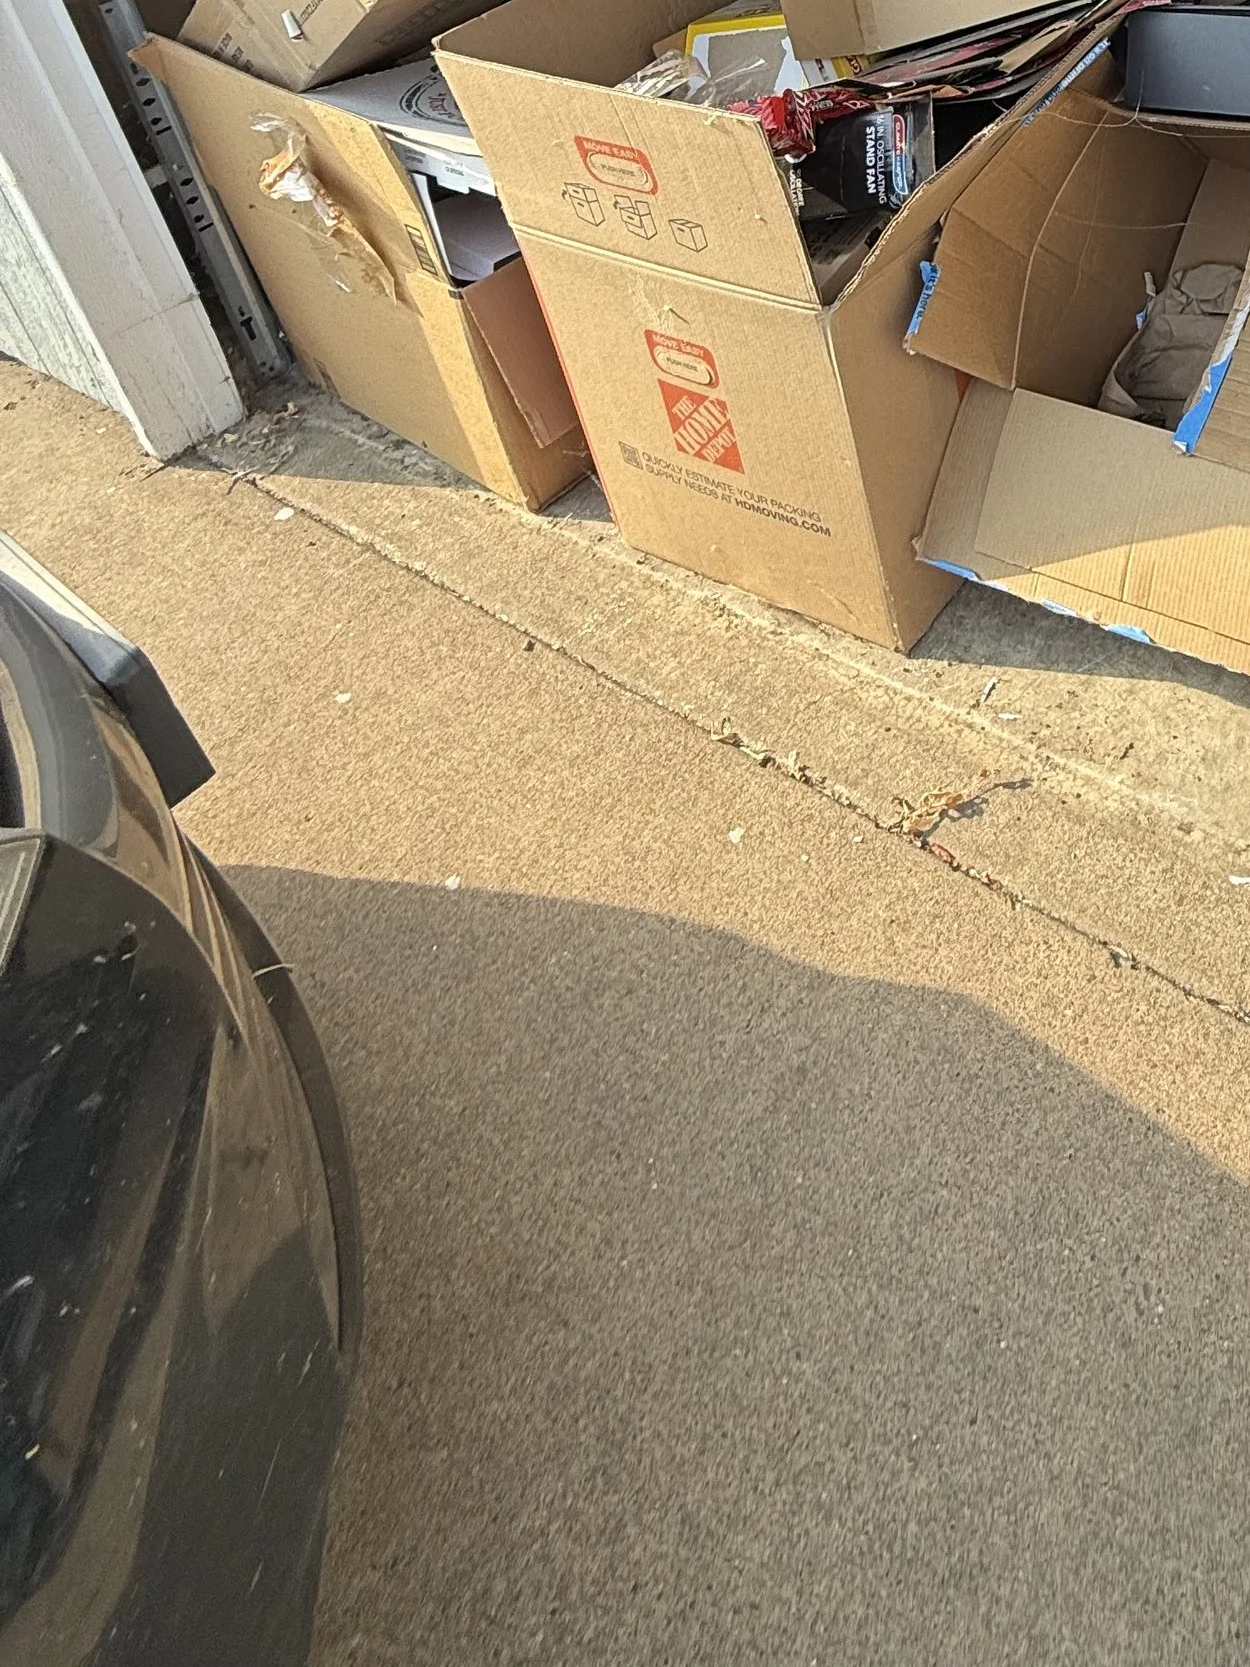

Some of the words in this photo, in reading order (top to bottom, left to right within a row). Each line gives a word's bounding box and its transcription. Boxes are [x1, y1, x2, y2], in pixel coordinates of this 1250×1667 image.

[866, 126, 876, 166] STAND
[866, 169, 877, 194] FAN
[877, 140, 888, 205] OSCILLATING
[652, 333, 680, 349] MOVE
[680, 341, 705, 358] EASY
[672, 395, 697, 420] THE
[674, 397, 730, 455] HOME
[701, 426, 737, 463] DEPOT
[642, 451, 683, 476] QUICKLY
[686, 469, 735, 495] ESTIMATE
[736, 487, 769, 506] YOUR
[770, 499, 821, 523] PACKING
[644, 464, 682, 486] SUPPLY
[684, 478, 719, 499] NEEDS
[721, 493, 734, 504] AT
[735, 498, 832, 537] HDMOVING.COM
